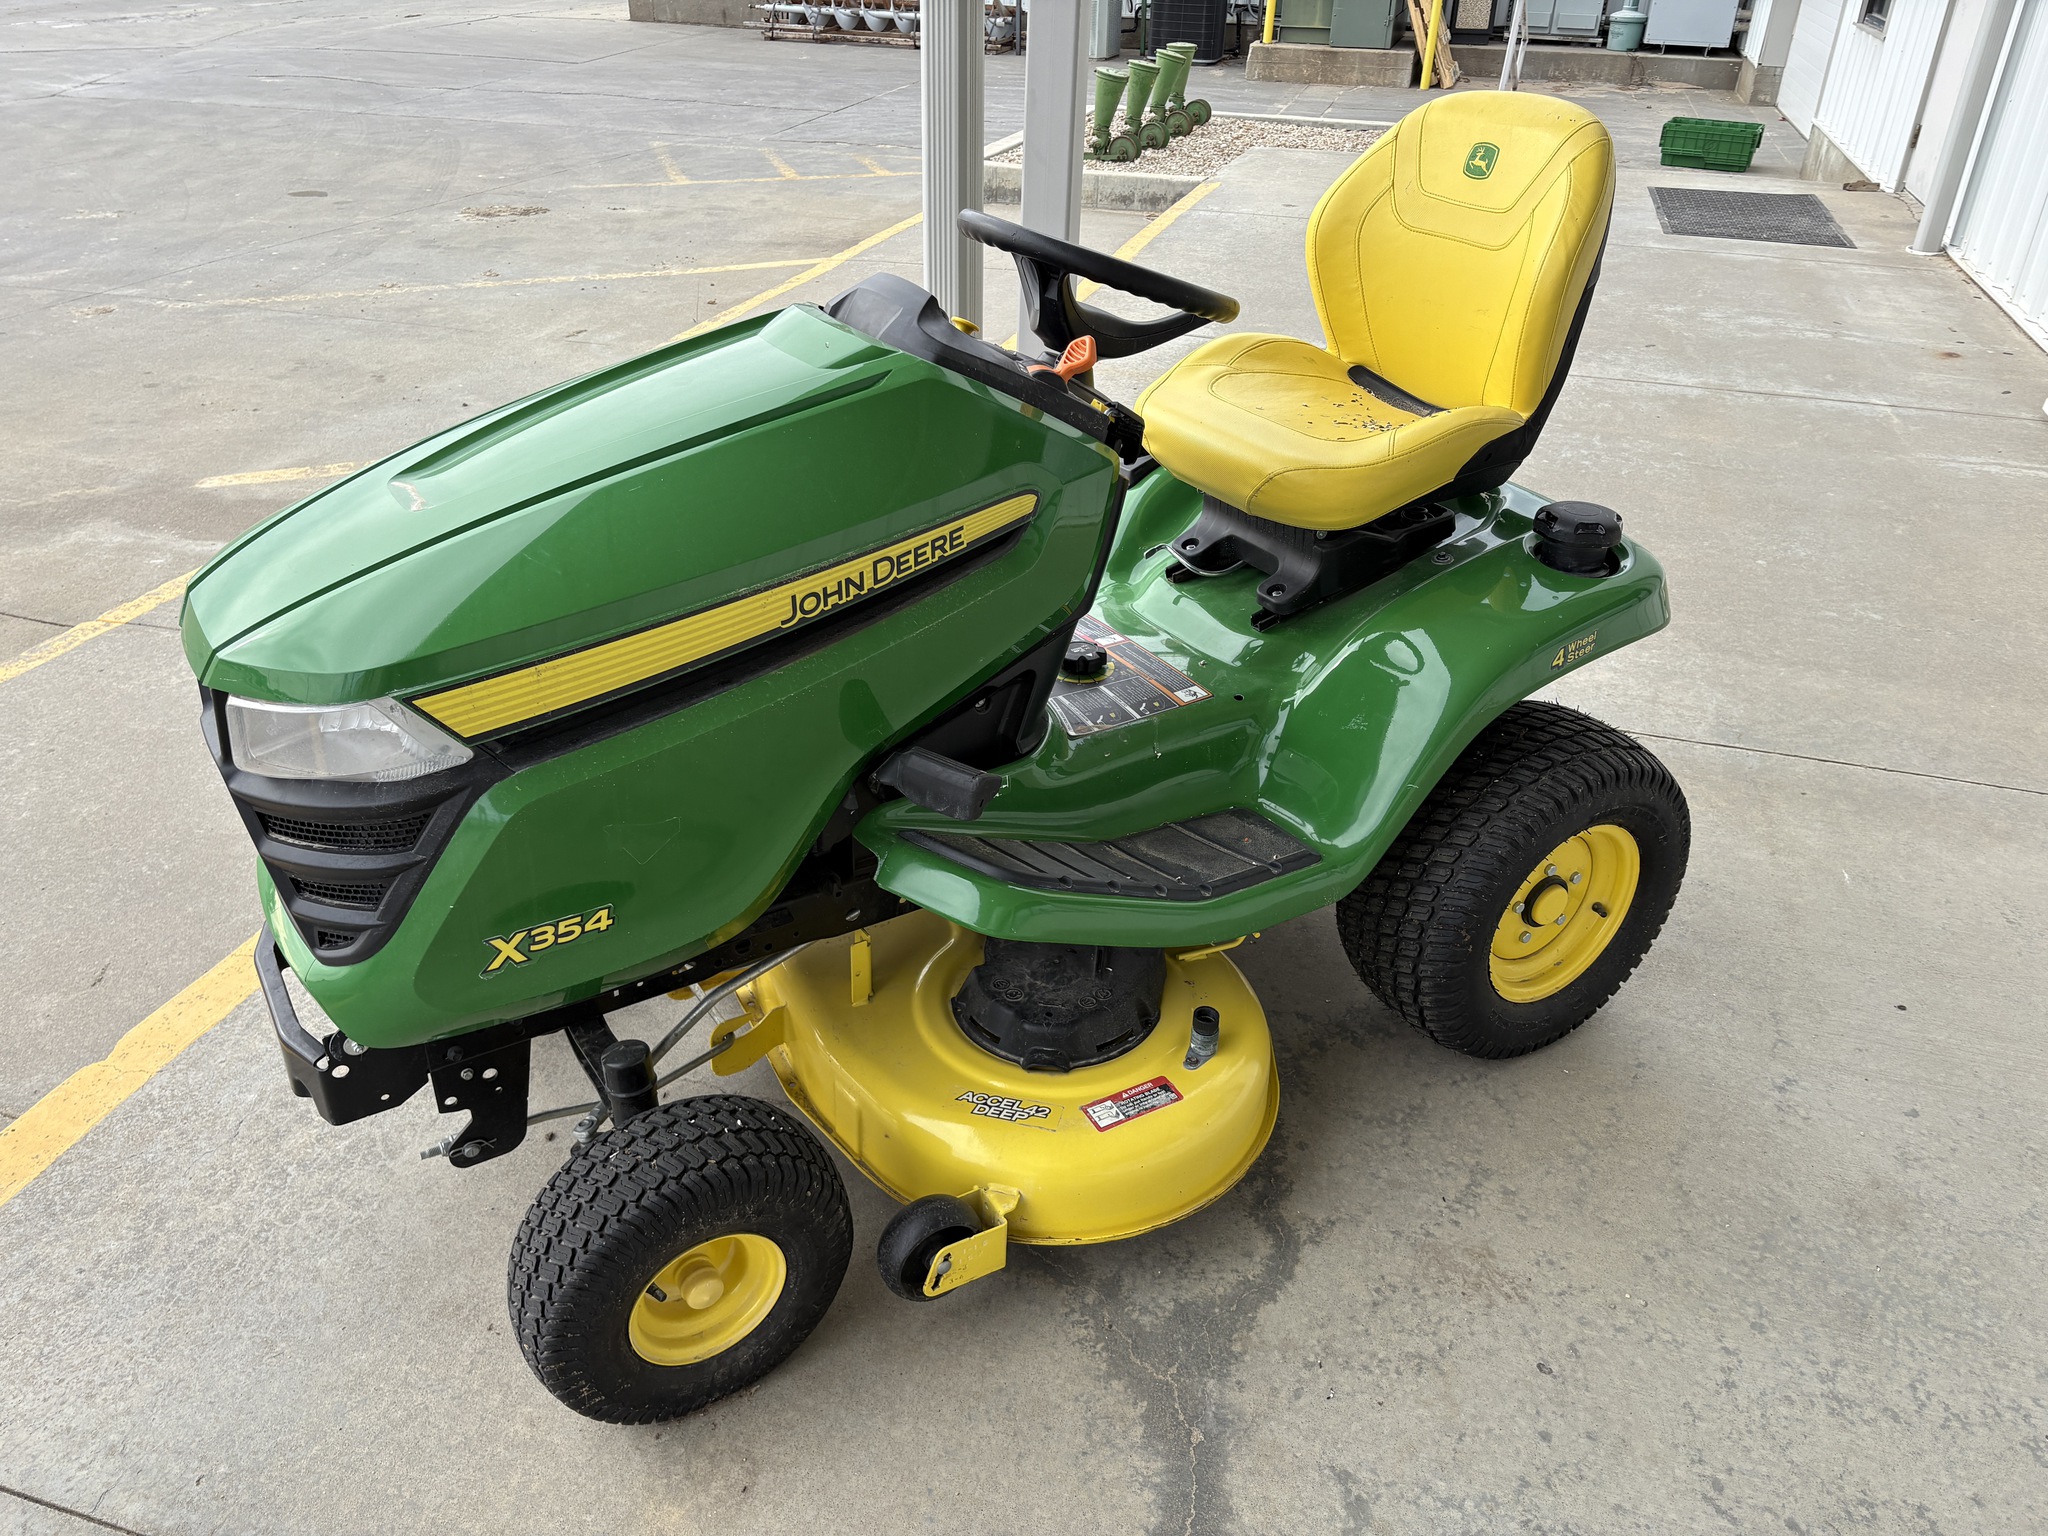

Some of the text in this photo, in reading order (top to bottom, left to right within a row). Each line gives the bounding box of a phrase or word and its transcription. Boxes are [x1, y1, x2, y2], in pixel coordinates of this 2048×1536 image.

[780, 525, 967, 627] JOHN DEERE
[1551, 630, 1597, 668] 4 Wheel
[1567, 643, 1595, 662] Steer
[482, 906, 614, 973] X354
[1127, 1082, 1154, 1095] DANGER
[955, 1091, 1051, 1118] ACCEL 42
[972, 1103, 1029, 1121] DEEP
